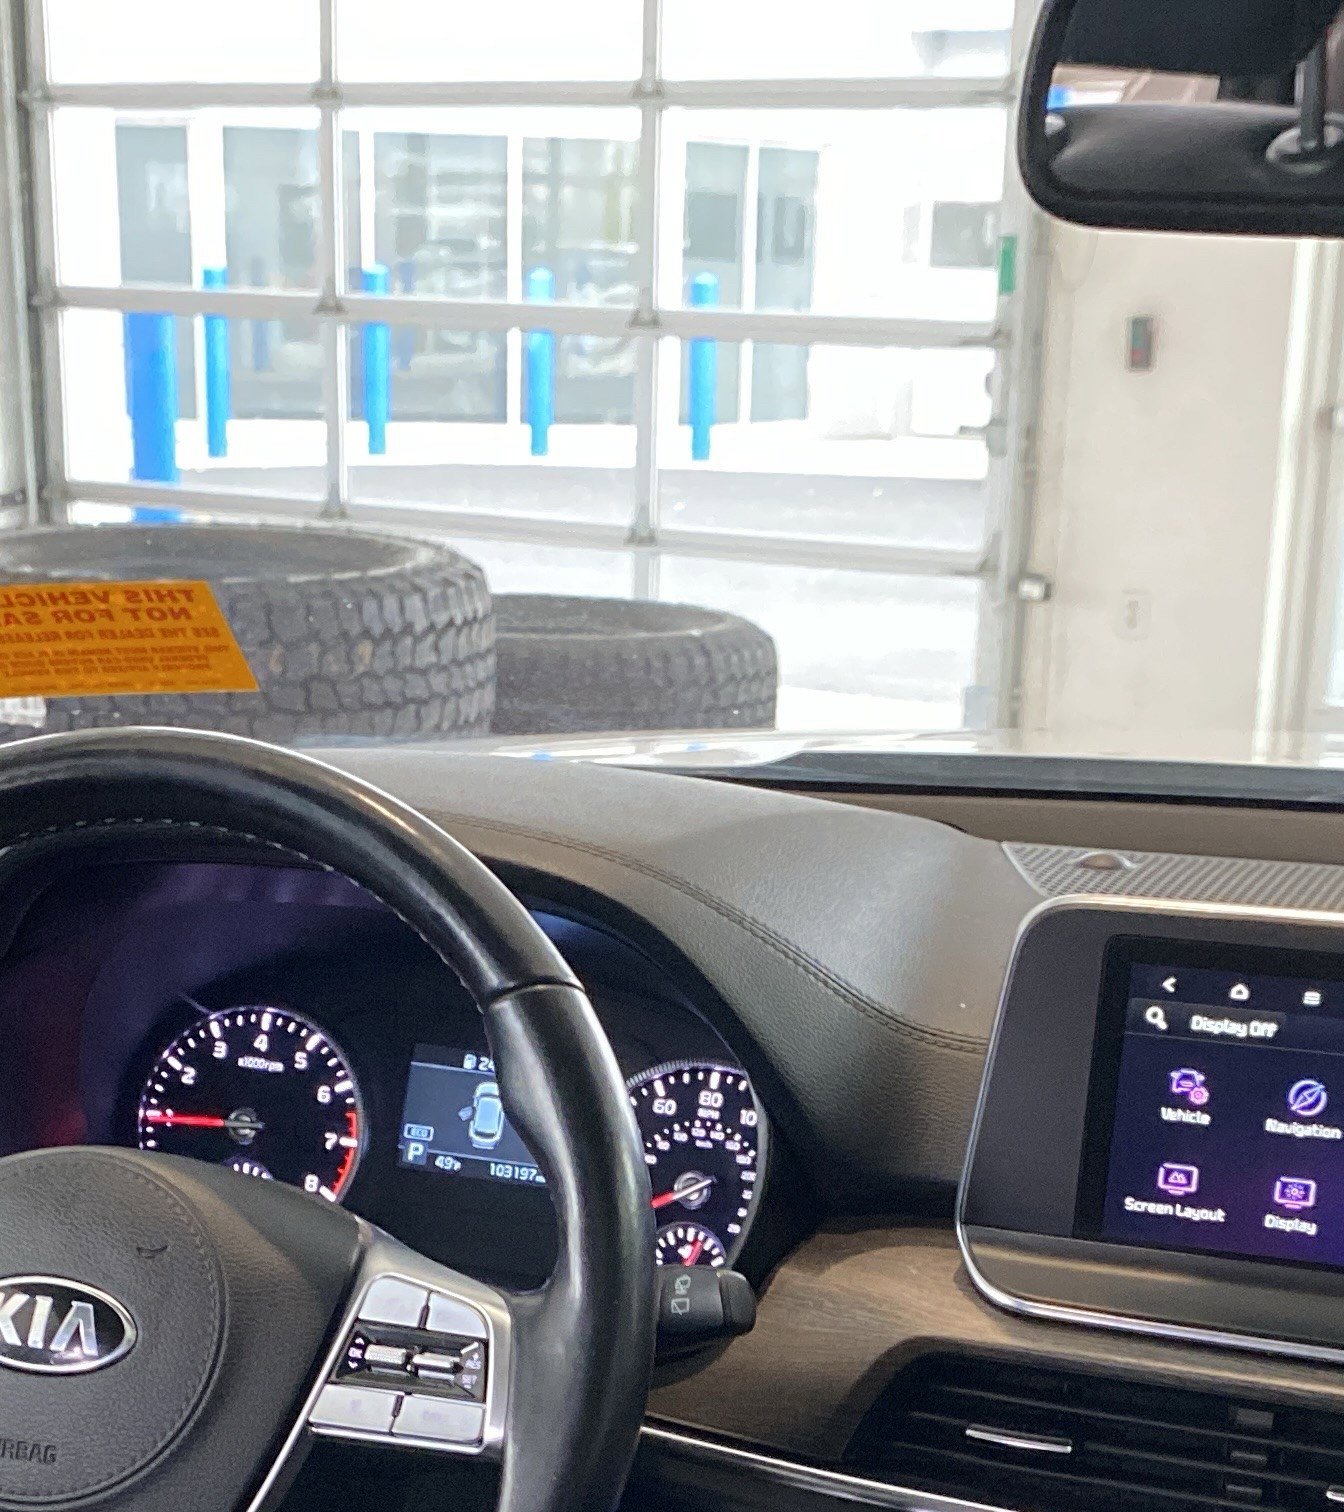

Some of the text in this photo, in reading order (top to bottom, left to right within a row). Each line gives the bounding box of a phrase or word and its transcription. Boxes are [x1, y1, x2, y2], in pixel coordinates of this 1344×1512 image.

[1189, 1014, 1279, 1038] Display Off
[212, 1040, 229, 1060] 3
[253, 1033, 269, 1052] 4
[293, 1051, 308, 1070] 5
[180, 1066, 197, 1085] 2
[317, 1085, 332, 1104] 6
[699, 1090, 723, 1108] 80
[653, 1099, 677, 1115] 60
[1160, 1106, 1211, 1126] Vehicle
[1264, 1117, 1344, 1140] Navigation
[324, 1132, 338, 1150] 7
[408, 1142, 424, 1161] P
[304, 1174, 320, 1193] 8
[1124, 1196, 1227, 1223] Screen Layout
[1264, 1214, 1318, 1236] Display
